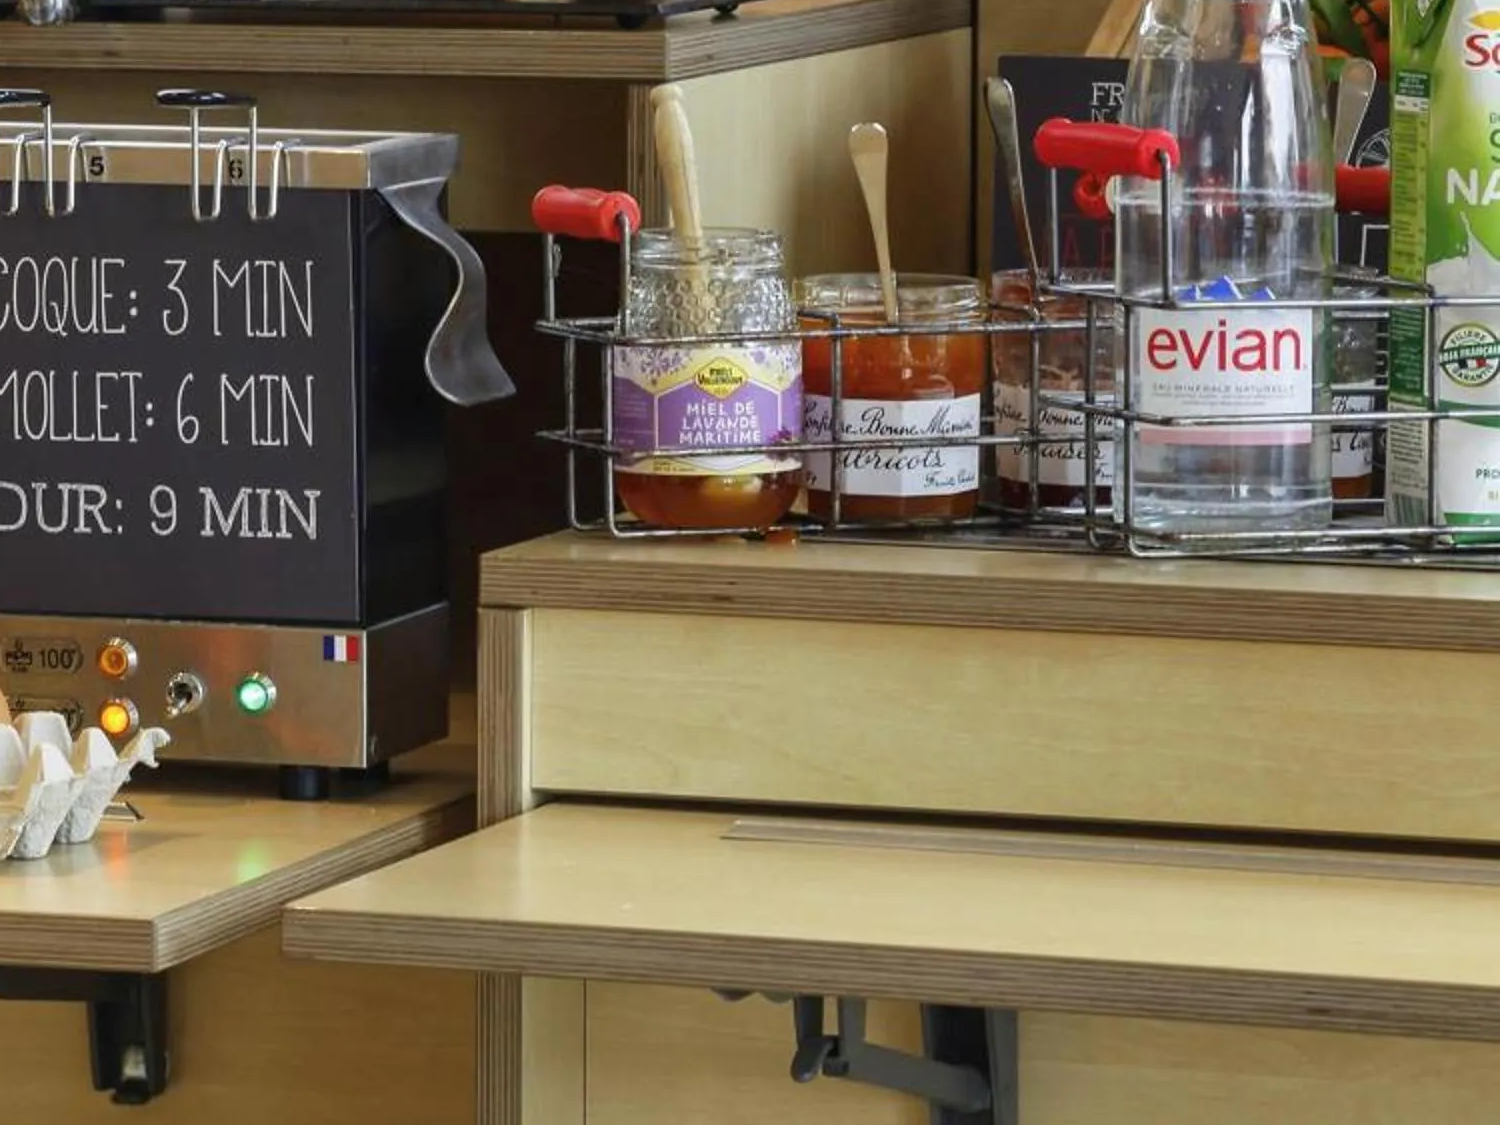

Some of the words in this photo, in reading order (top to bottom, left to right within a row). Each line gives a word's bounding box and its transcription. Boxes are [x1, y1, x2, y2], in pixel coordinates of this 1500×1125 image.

[89, 156, 105, 177] 5
[228, 159, 244, 180] 6
[163, 259, 189, 336] 3
[213, 259, 315, 338] MIN
[1147, 318, 1301, 372] evian
[177, 372, 200, 444] 6
[220, 373, 315, 448] MIN
[149, 484, 178, 537] 9
[199, 486, 322, 540] MIN
